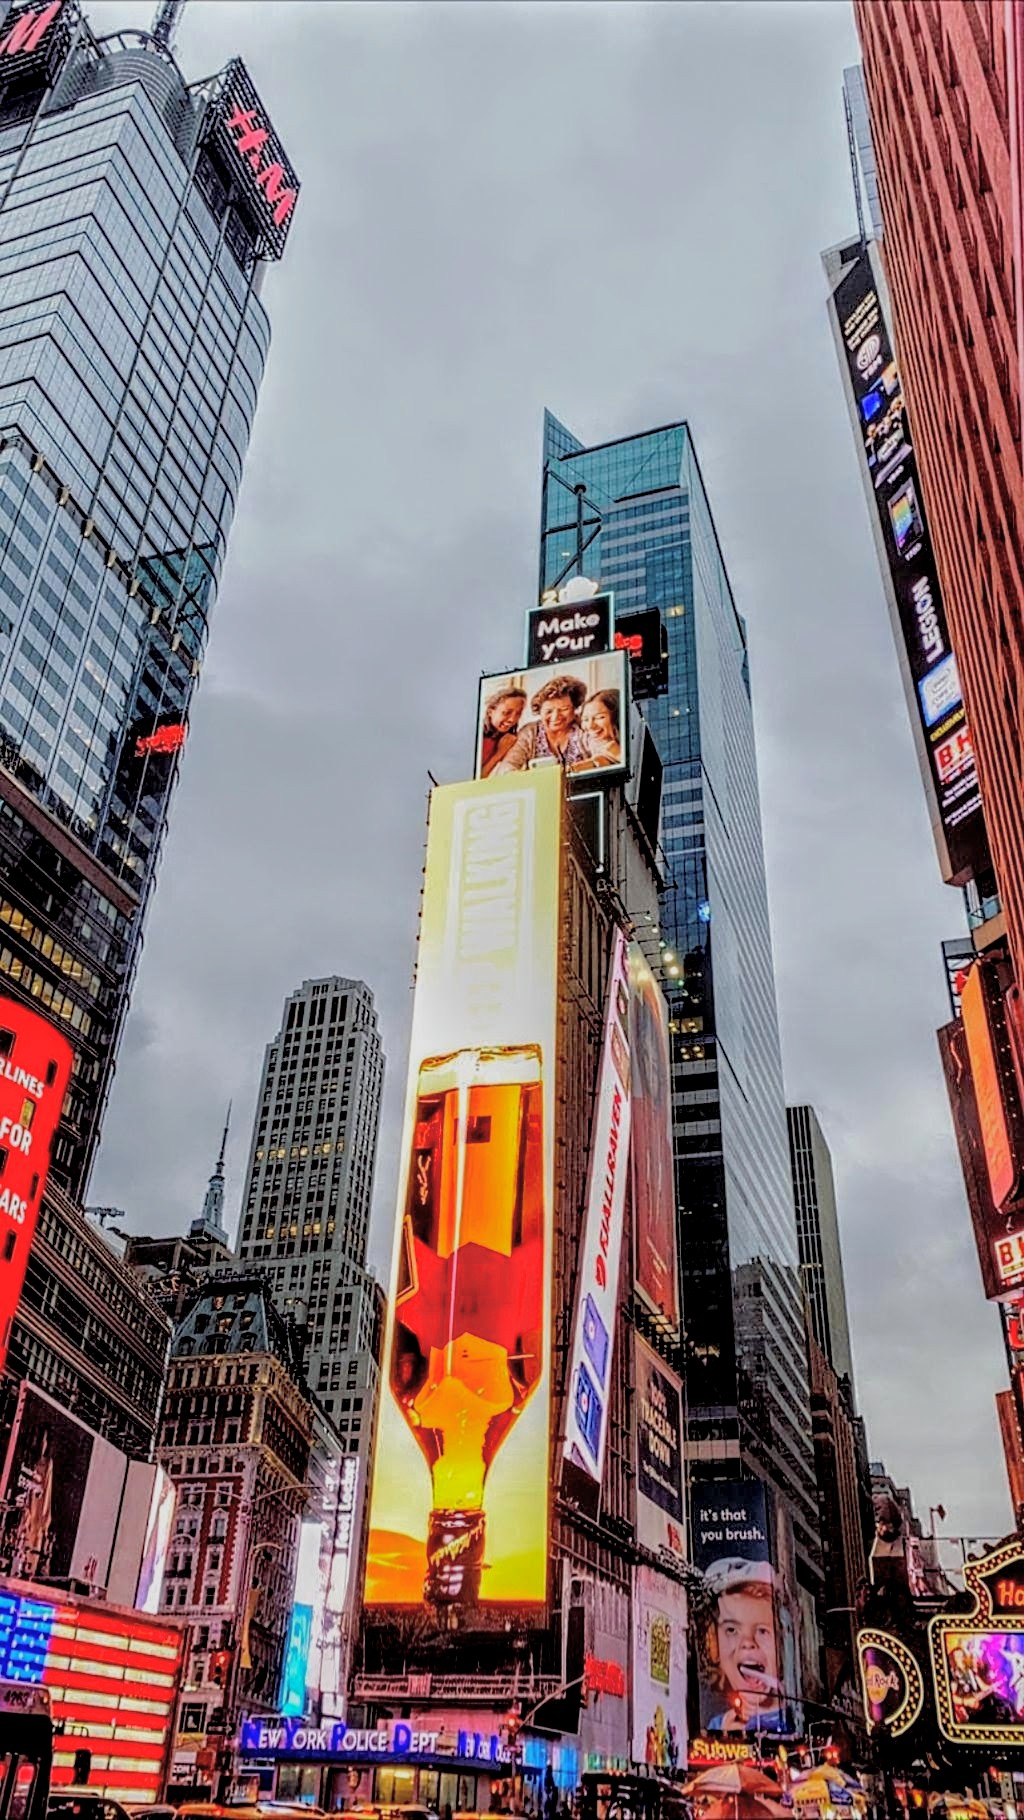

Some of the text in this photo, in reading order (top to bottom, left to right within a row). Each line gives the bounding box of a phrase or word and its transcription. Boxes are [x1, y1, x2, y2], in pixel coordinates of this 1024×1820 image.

[537, 612, 600, 638] Make
[912, 576, 944, 663] LEGION
[541, 634, 595, 660] your
[0, 1116, 32, 1156] FOR
[0, 1184, 27, 1224] ARS
[700, 1506, 746, 1522] it's that
[701, 1526, 765, 1544] you brush.
[283, 1719, 327, 1751] YORK
[331, 1723, 388, 1752] POLICE
[393, 1723, 438, 1754] DEPT
